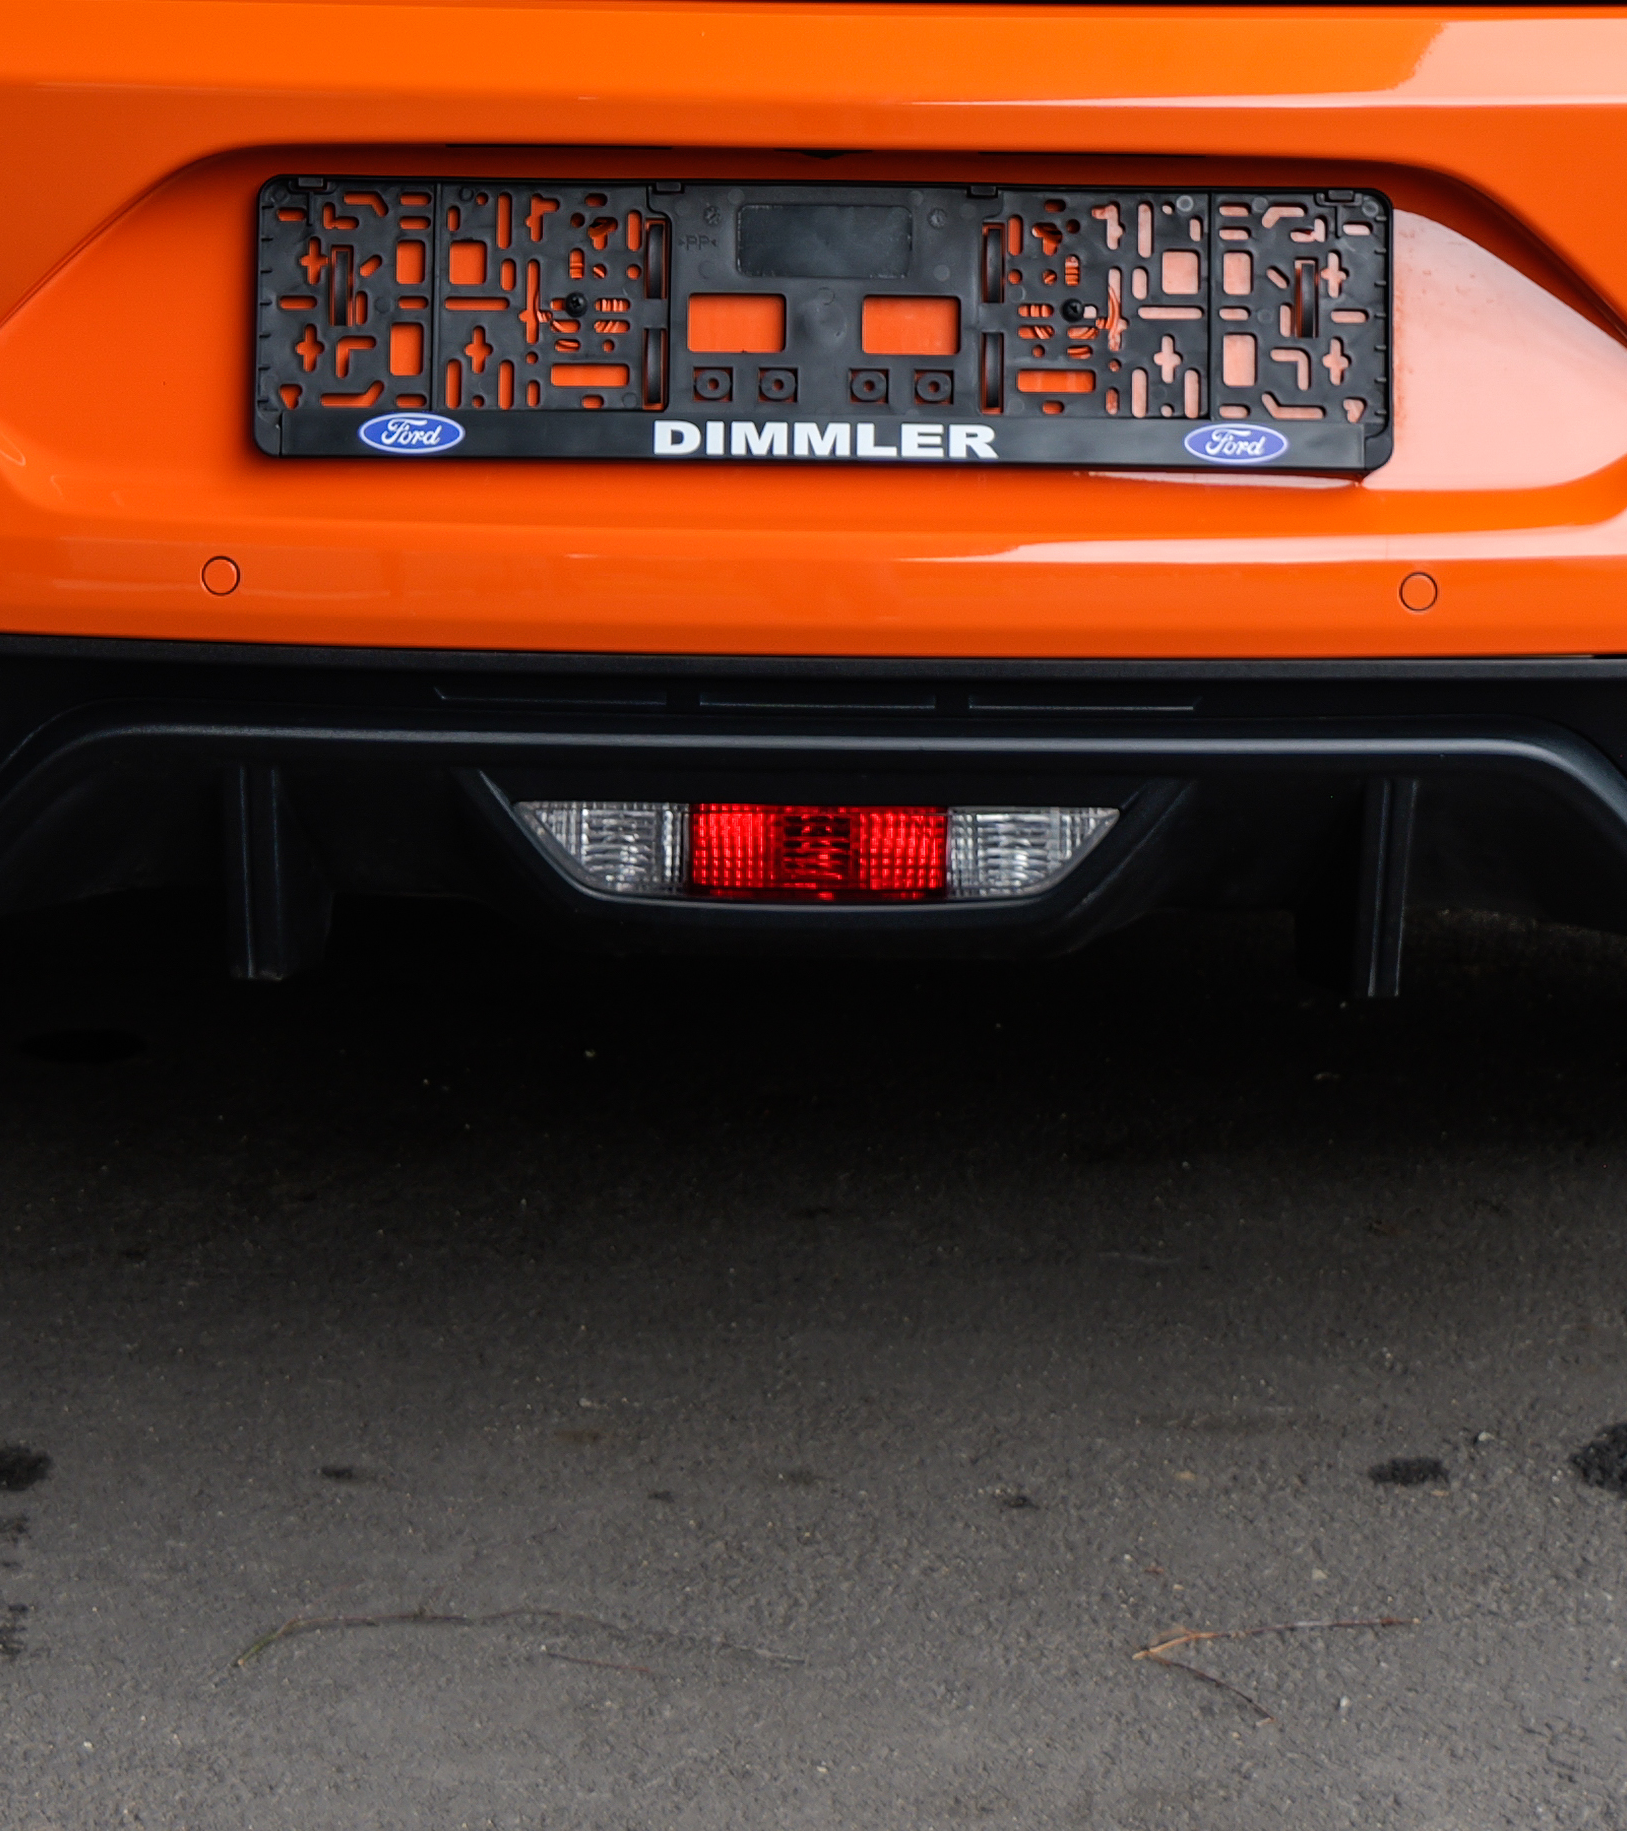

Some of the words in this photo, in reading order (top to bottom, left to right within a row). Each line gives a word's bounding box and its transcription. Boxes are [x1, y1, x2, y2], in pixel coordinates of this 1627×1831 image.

[381, 418, 443, 446] Ford
[653, 420, 999, 459] DIMMLER
[1205, 428, 1267, 456] Ford
